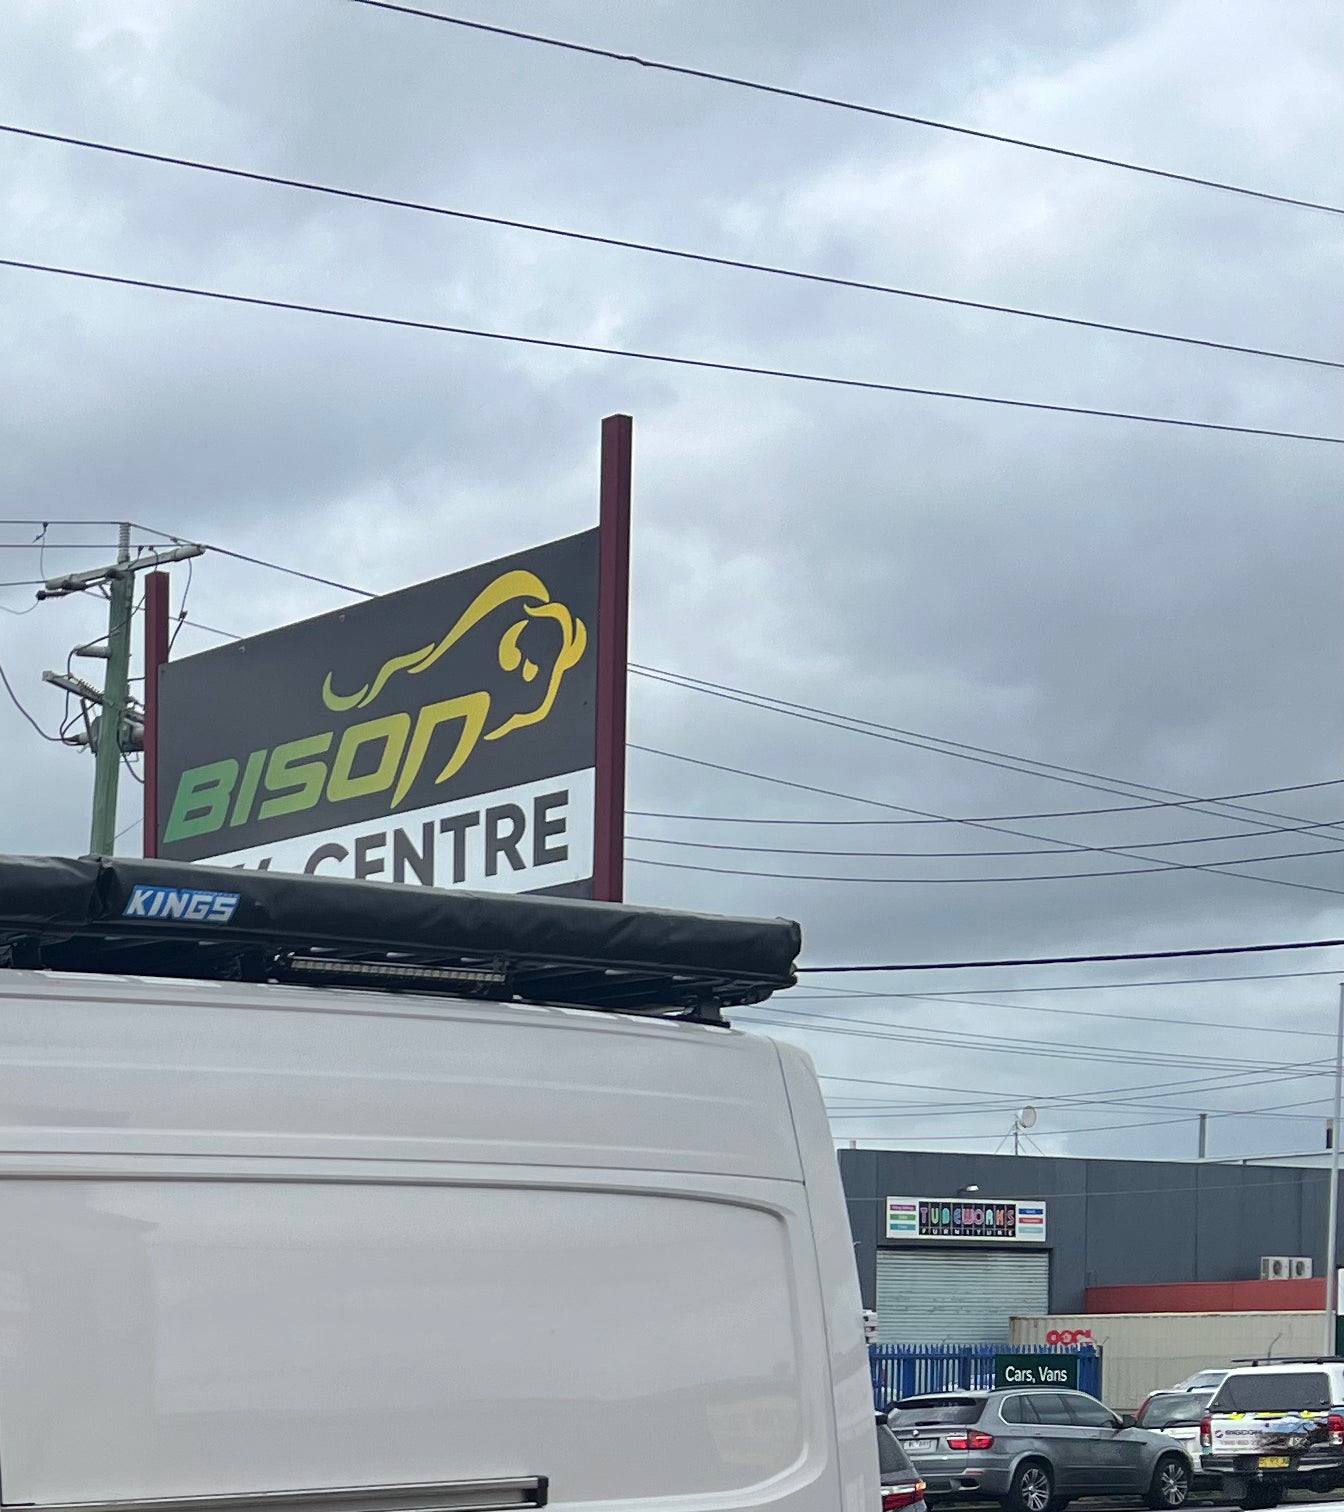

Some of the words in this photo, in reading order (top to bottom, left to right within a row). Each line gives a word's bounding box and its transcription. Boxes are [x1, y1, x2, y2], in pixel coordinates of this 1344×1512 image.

[163, 691, 491, 843] BISON
[126, 889, 238, 921] KINGS
[1005, 1365, 1036, 1384] Cars,
[1038, 1366, 1068, 1382] Vans
